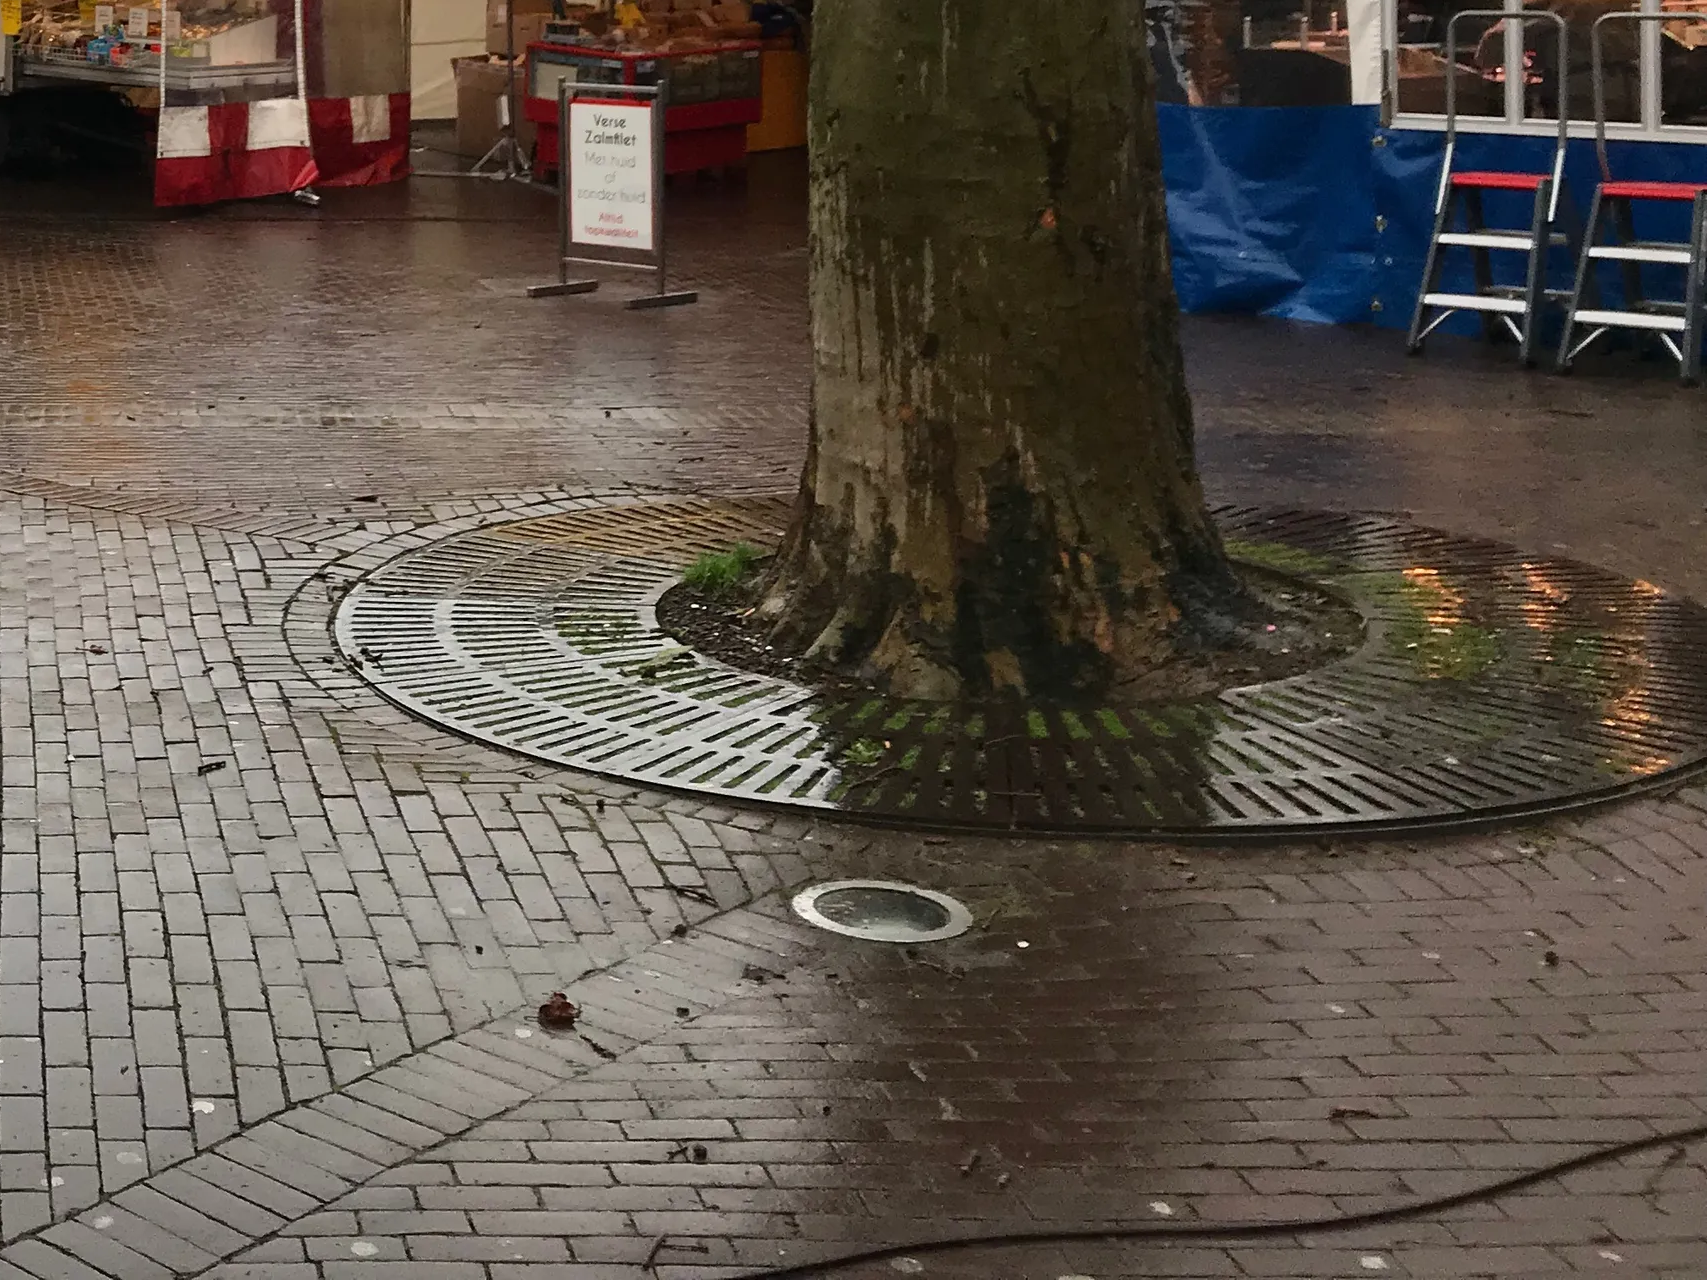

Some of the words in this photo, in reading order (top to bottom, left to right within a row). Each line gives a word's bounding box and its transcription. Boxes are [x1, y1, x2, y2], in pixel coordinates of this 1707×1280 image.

[593, 113, 627, 128] Verse
[584, 130, 637, 147] Zalmfilet
[604, 171, 616, 184] of
